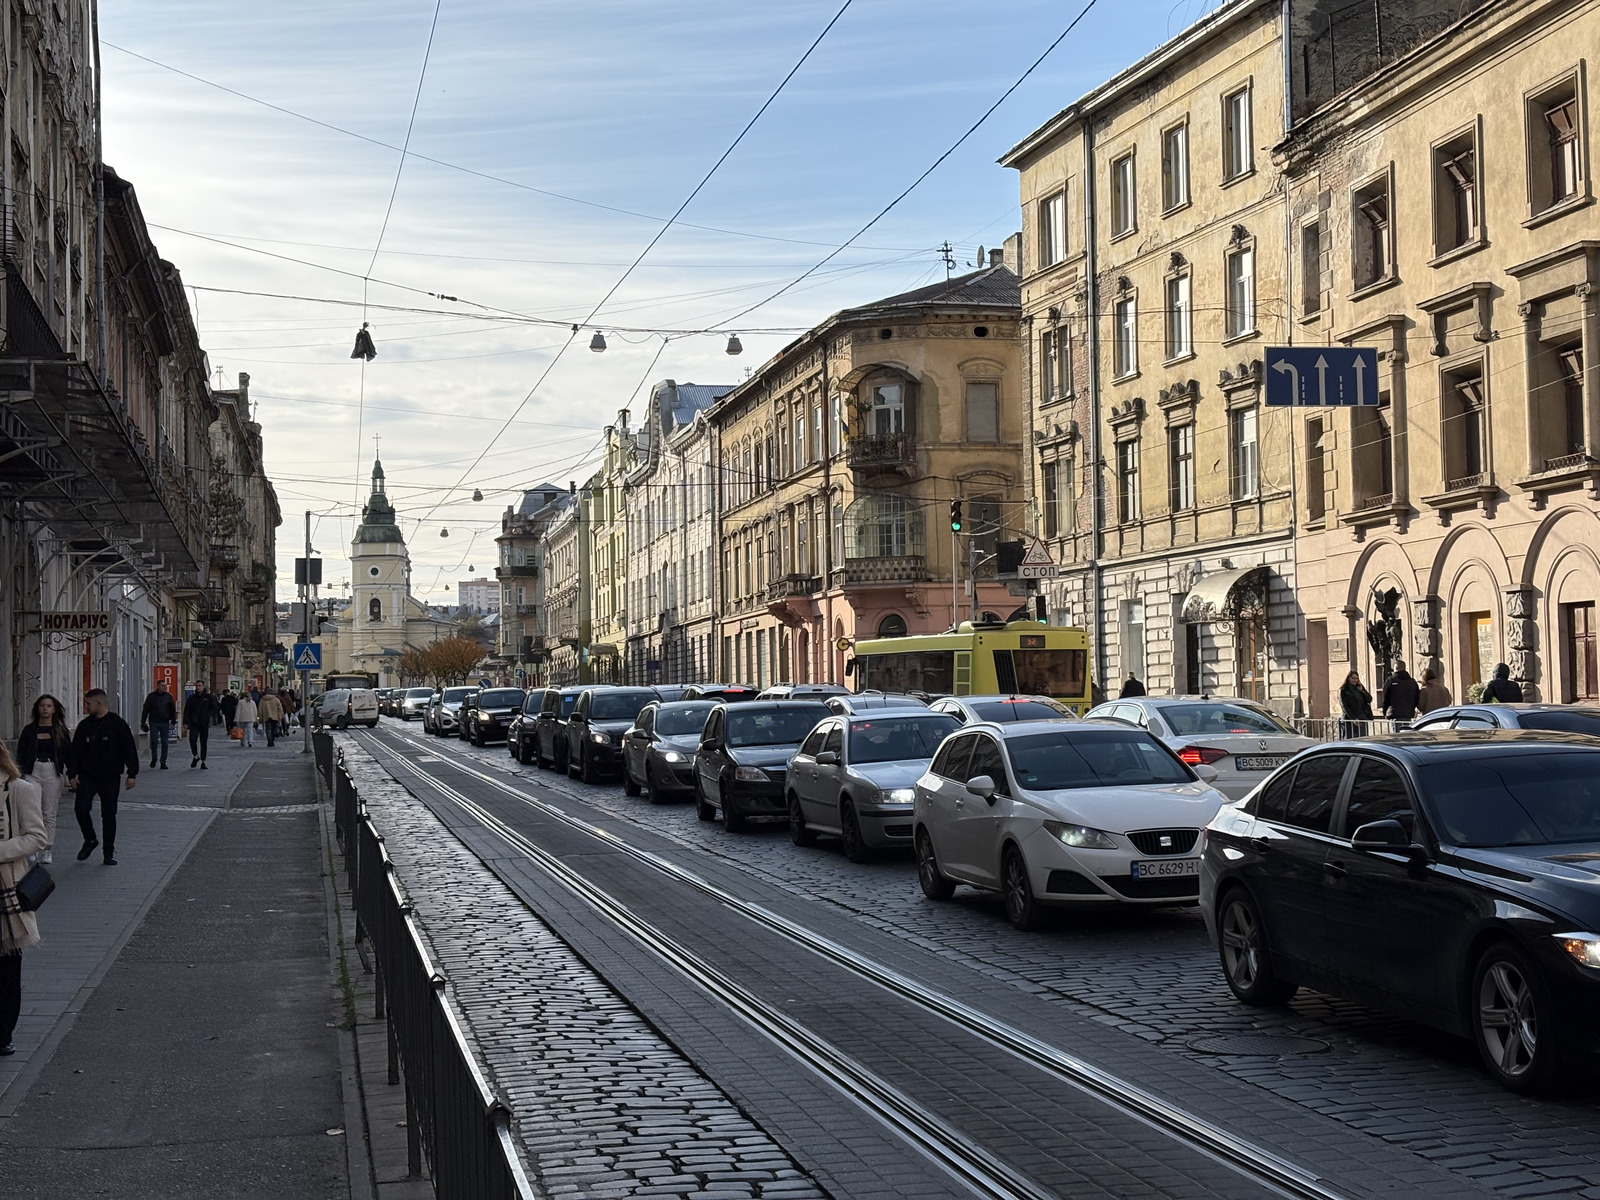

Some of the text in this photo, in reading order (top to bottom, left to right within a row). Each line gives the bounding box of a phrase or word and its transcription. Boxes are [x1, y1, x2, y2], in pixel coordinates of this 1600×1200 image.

[1023, 567, 1055, 577] СТОП
[44, 614, 108, 629] НОТАРІУС
[1242, 759, 1254, 767] BC
[1256, 758, 1273, 767] 5009
[1140, 861, 1199, 876] BC 6629 H
